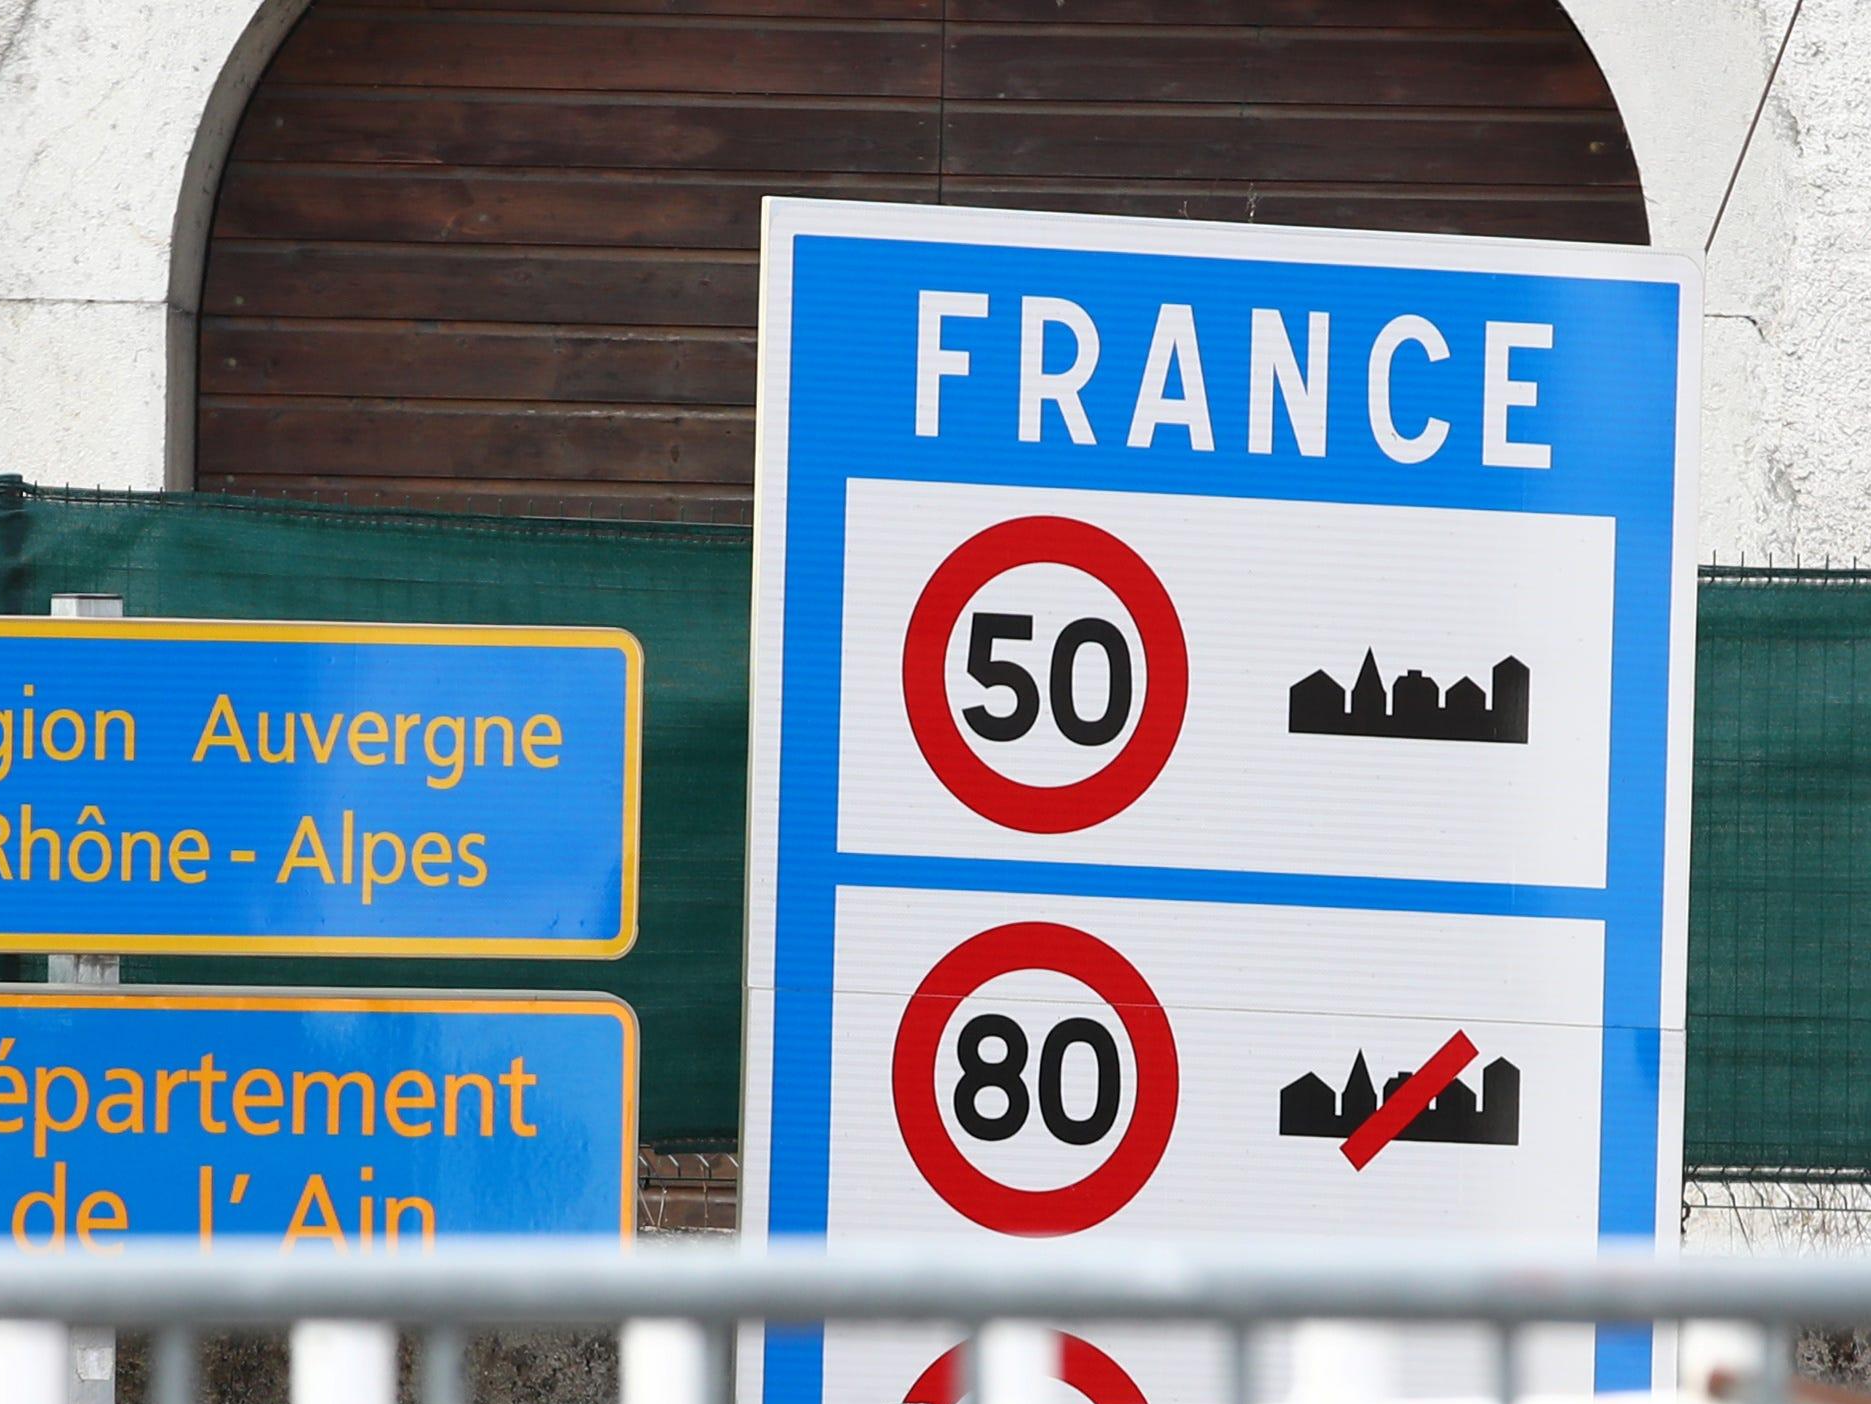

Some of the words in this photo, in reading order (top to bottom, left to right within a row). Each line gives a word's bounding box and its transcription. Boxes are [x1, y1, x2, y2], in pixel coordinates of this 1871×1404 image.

[915, 289, 1555, 469] FRANCE
[961, 611, 1133, 747] 50
[192, 694, 563, 789] Auvergne
[277, 810, 488, 905] Alpes
[953, 1013, 1121, 1146] 80
[11, 1161, 129, 1256] de
